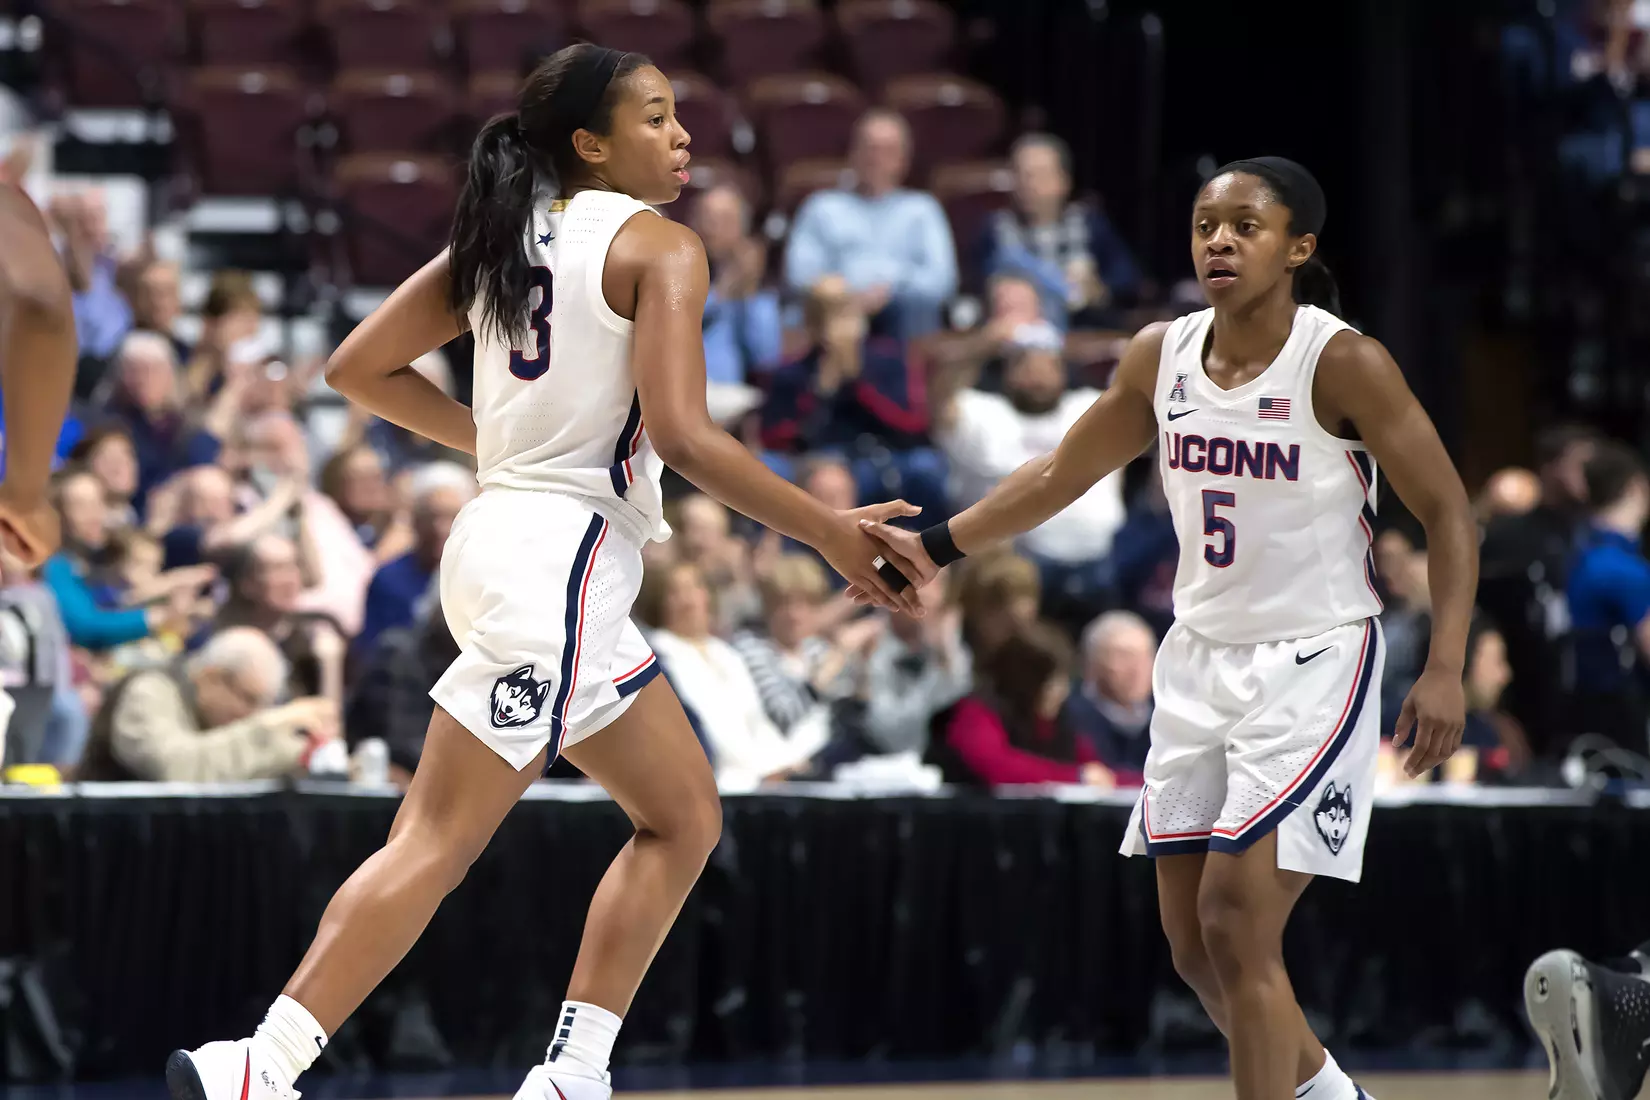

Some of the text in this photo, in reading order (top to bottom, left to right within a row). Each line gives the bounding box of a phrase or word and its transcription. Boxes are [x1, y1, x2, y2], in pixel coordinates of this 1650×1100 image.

[508, 265, 554, 382] 3
[1165, 431, 1300, 482] UCONN
[1201, 489, 1236, 569] 5
